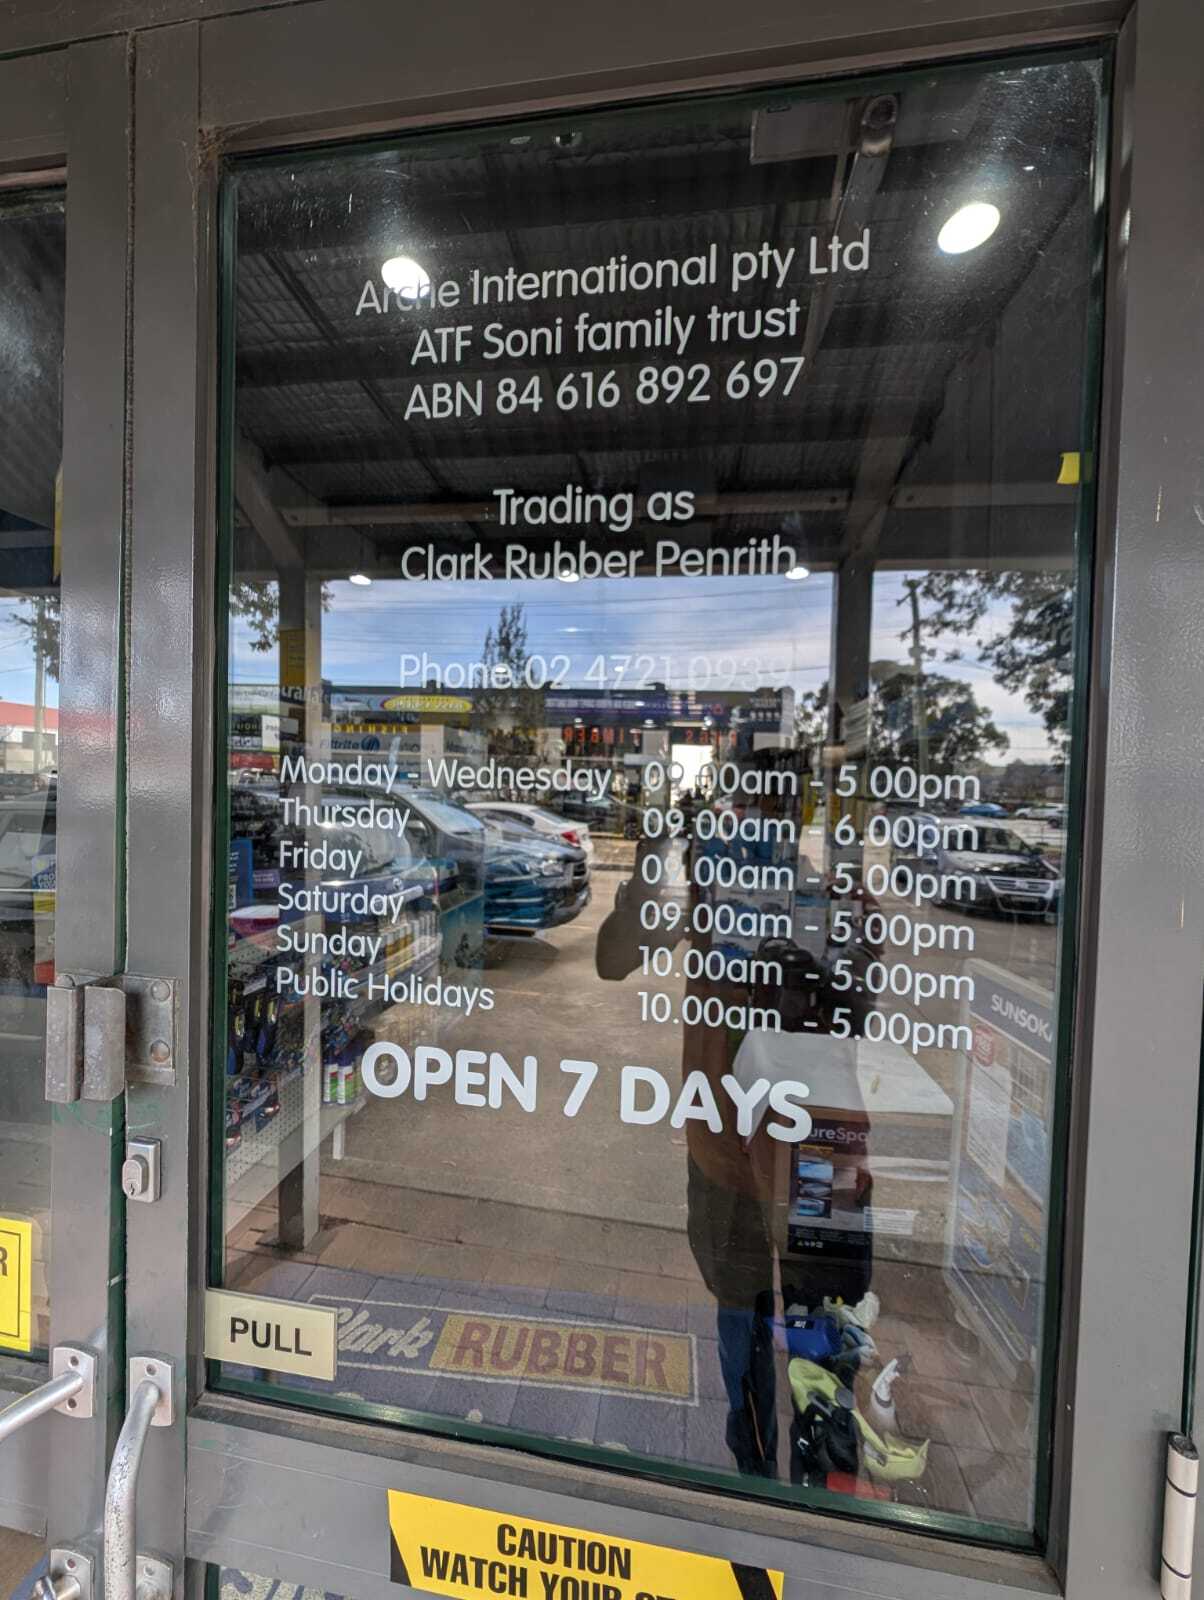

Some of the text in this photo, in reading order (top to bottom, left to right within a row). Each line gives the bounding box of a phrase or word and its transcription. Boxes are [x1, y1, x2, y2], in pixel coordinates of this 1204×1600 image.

[472, 243, 717, 305] International
[731, 241, 796, 293] pty
[808, 228, 870, 275] Ltd
[411, 298, 801, 366] ATF Soni family trust
[404, 357, 805, 421] ABN 84 616 892 697
[493, 484, 696, 533] Trading as
[401, 533, 798, 583] Clark Rubber Penrith
[526, 654, 571, 691] 02
[279, 755, 398, 794] Monday
[427, 758, 613, 801] Wednesday
[643, 760, 798, 796] 0900am
[279, 797, 410, 837] Thursday
[642, 807, 796, 844] 09.00am
[834, 814, 979, 857] 6.00pm
[278, 840, 363, 879] Friday
[831, 863, 977, 906] 5.00pm
[277, 883, 404, 923] Saturday
[639, 900, 793, 938] 09.00am
[829, 911, 976, 955] 5.00pm
[275, 926, 382, 965] Sunday
[638, 945, 783, 986] 10.00am
[830, 959, 976, 1005] 5.00pm
[275, 966, 359, 1000] Public
[368, 973, 495, 1016] Holidays
[637, 991, 782, 1033] 10.00am
[829, 1008, 974, 1054] 5.00pm
[361, 1041, 813, 1143] OPEN 7 DAYS
[230, 1316, 312, 1356] PULL
[451, 1320, 668, 1390] RUBBER
[419, 1545, 527, 1599] WATCH
[496, 1523, 631, 1581] CAUTION
